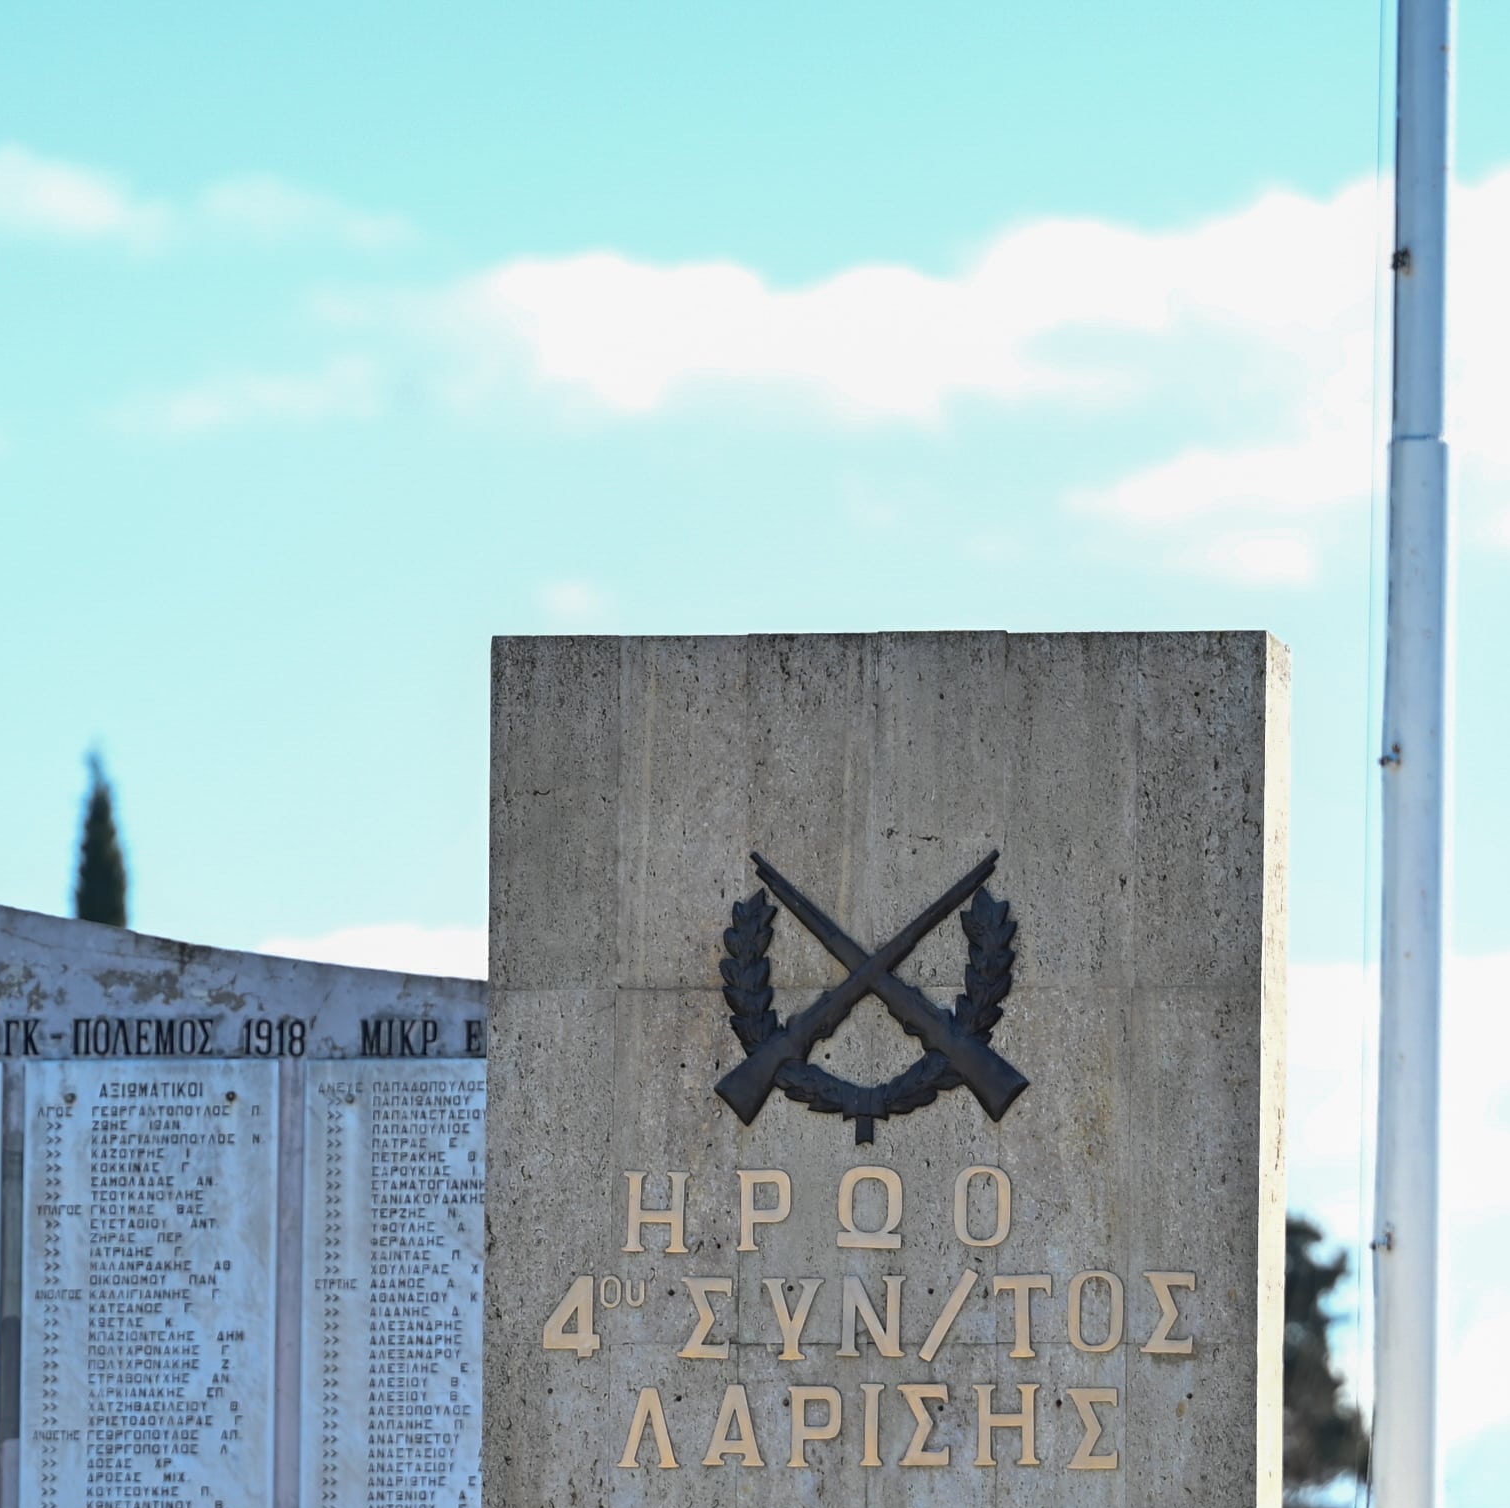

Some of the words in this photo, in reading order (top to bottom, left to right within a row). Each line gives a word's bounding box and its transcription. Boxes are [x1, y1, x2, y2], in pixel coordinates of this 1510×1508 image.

[243, 1017, 307, 1057] 1918
[99, 1081, 203, 1100] ΑΞΙΩΜΑΤΙΚΟΙ
[622, 1165, 1013, 1254] ΗΡΩΟ
[677, 1268, 1197, 1362] ΣΥΝ/ΤΟΣ
[616, 1382, 1121, 1471] ΛΑΡΙΣΗΣ
